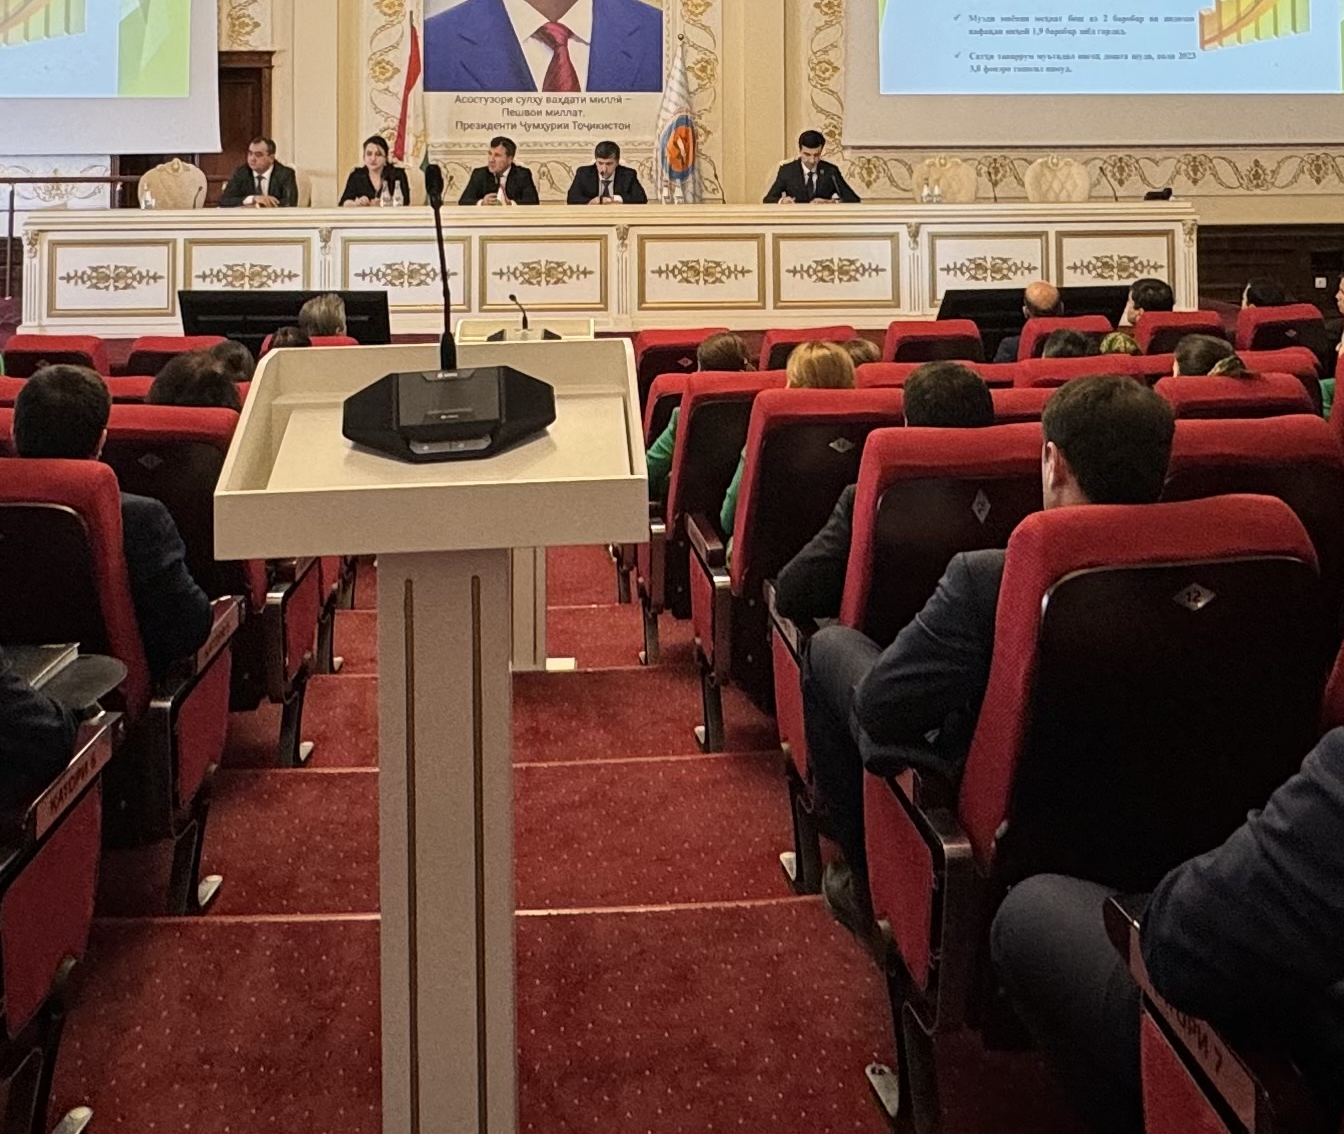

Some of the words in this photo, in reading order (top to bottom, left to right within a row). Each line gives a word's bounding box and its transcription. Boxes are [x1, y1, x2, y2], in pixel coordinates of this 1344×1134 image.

[454, 95, 514, 106] Асостузори
[516, 96, 543, 106] сулҳу
[546, 96, 586, 105] ваҳдати
[455, 120, 518, 133] Президенти
[519, 121, 570, 133] Ҷумҳурии
[572, 121, 631, 132] Тоҷикистон
[1186, 590, 1202, 604] 12
